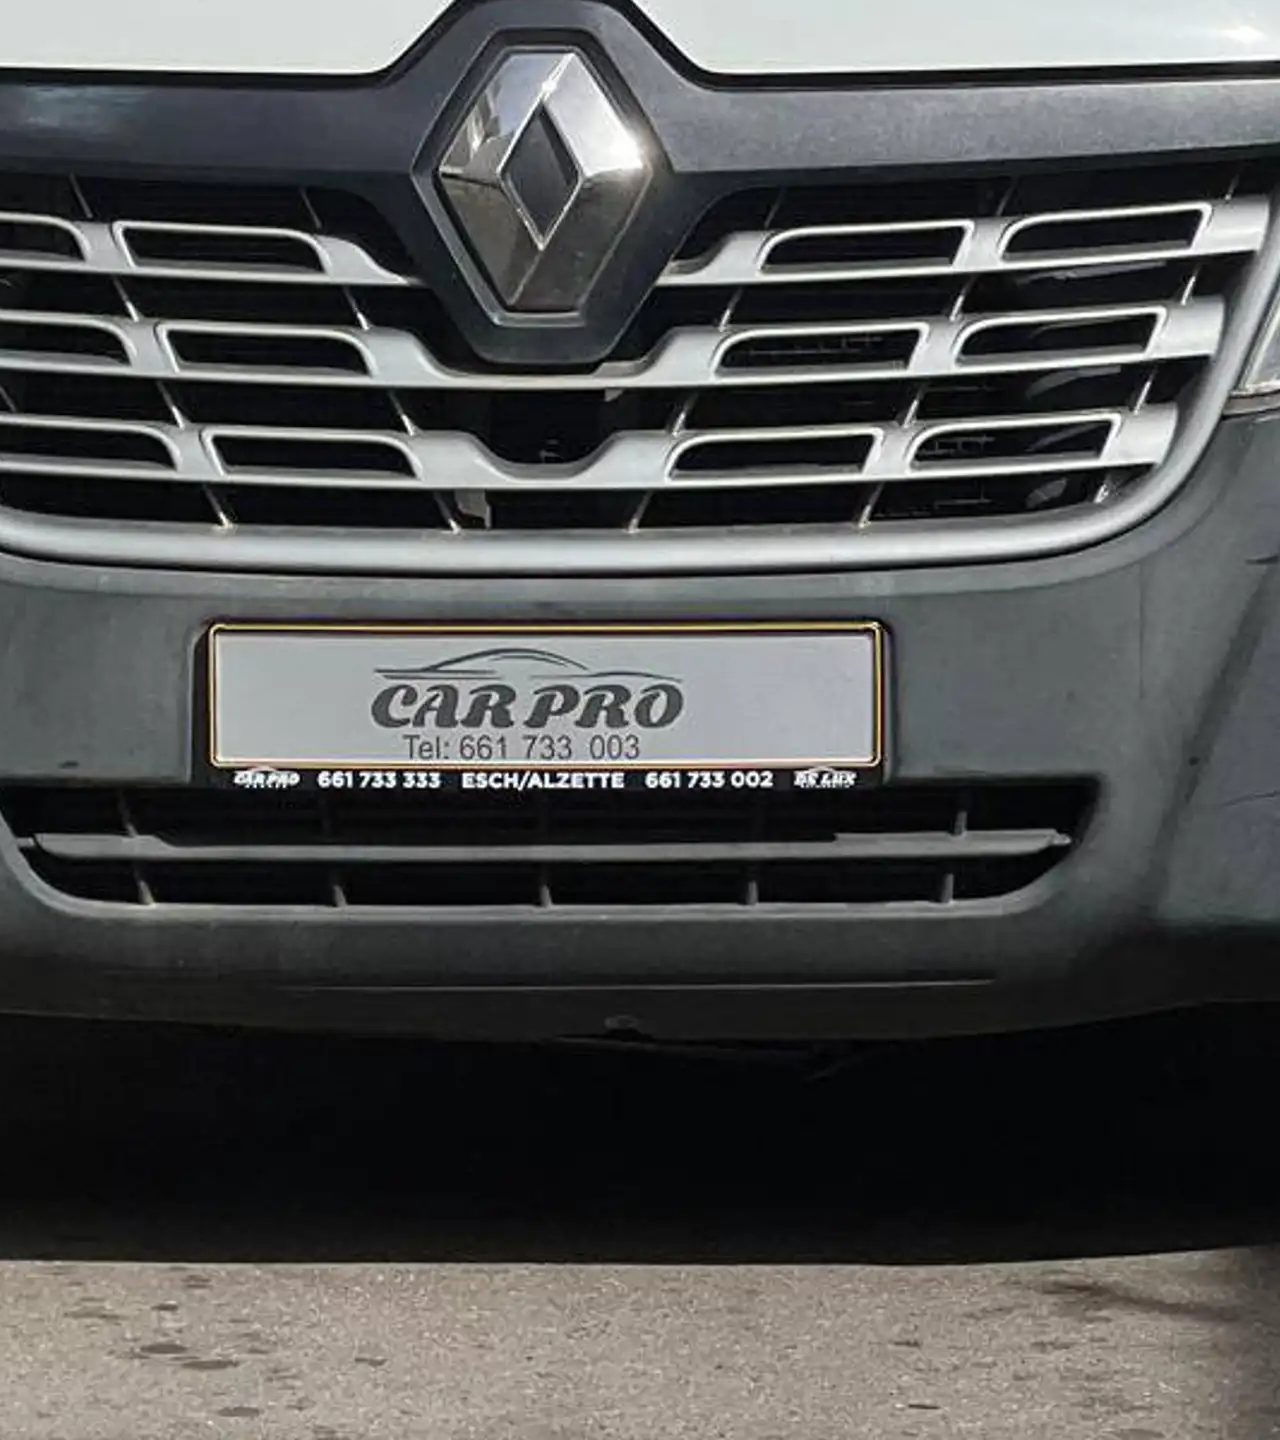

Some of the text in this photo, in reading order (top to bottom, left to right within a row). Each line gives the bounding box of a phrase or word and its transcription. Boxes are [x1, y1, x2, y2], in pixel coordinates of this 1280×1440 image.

[371, 684, 685, 728] CAR PRO
[402, 734, 640, 760] Tel: 661 733 003
[317, 771, 353, 789] 661
[359, 771, 397, 789] 733
[402, 771, 442, 789] 333
[461, 771, 625, 791] ESCH/ALZETTE
[644, 771, 681, 789] 661
[687, 771, 725, 789] 733
[730, 771, 774, 789] 002
